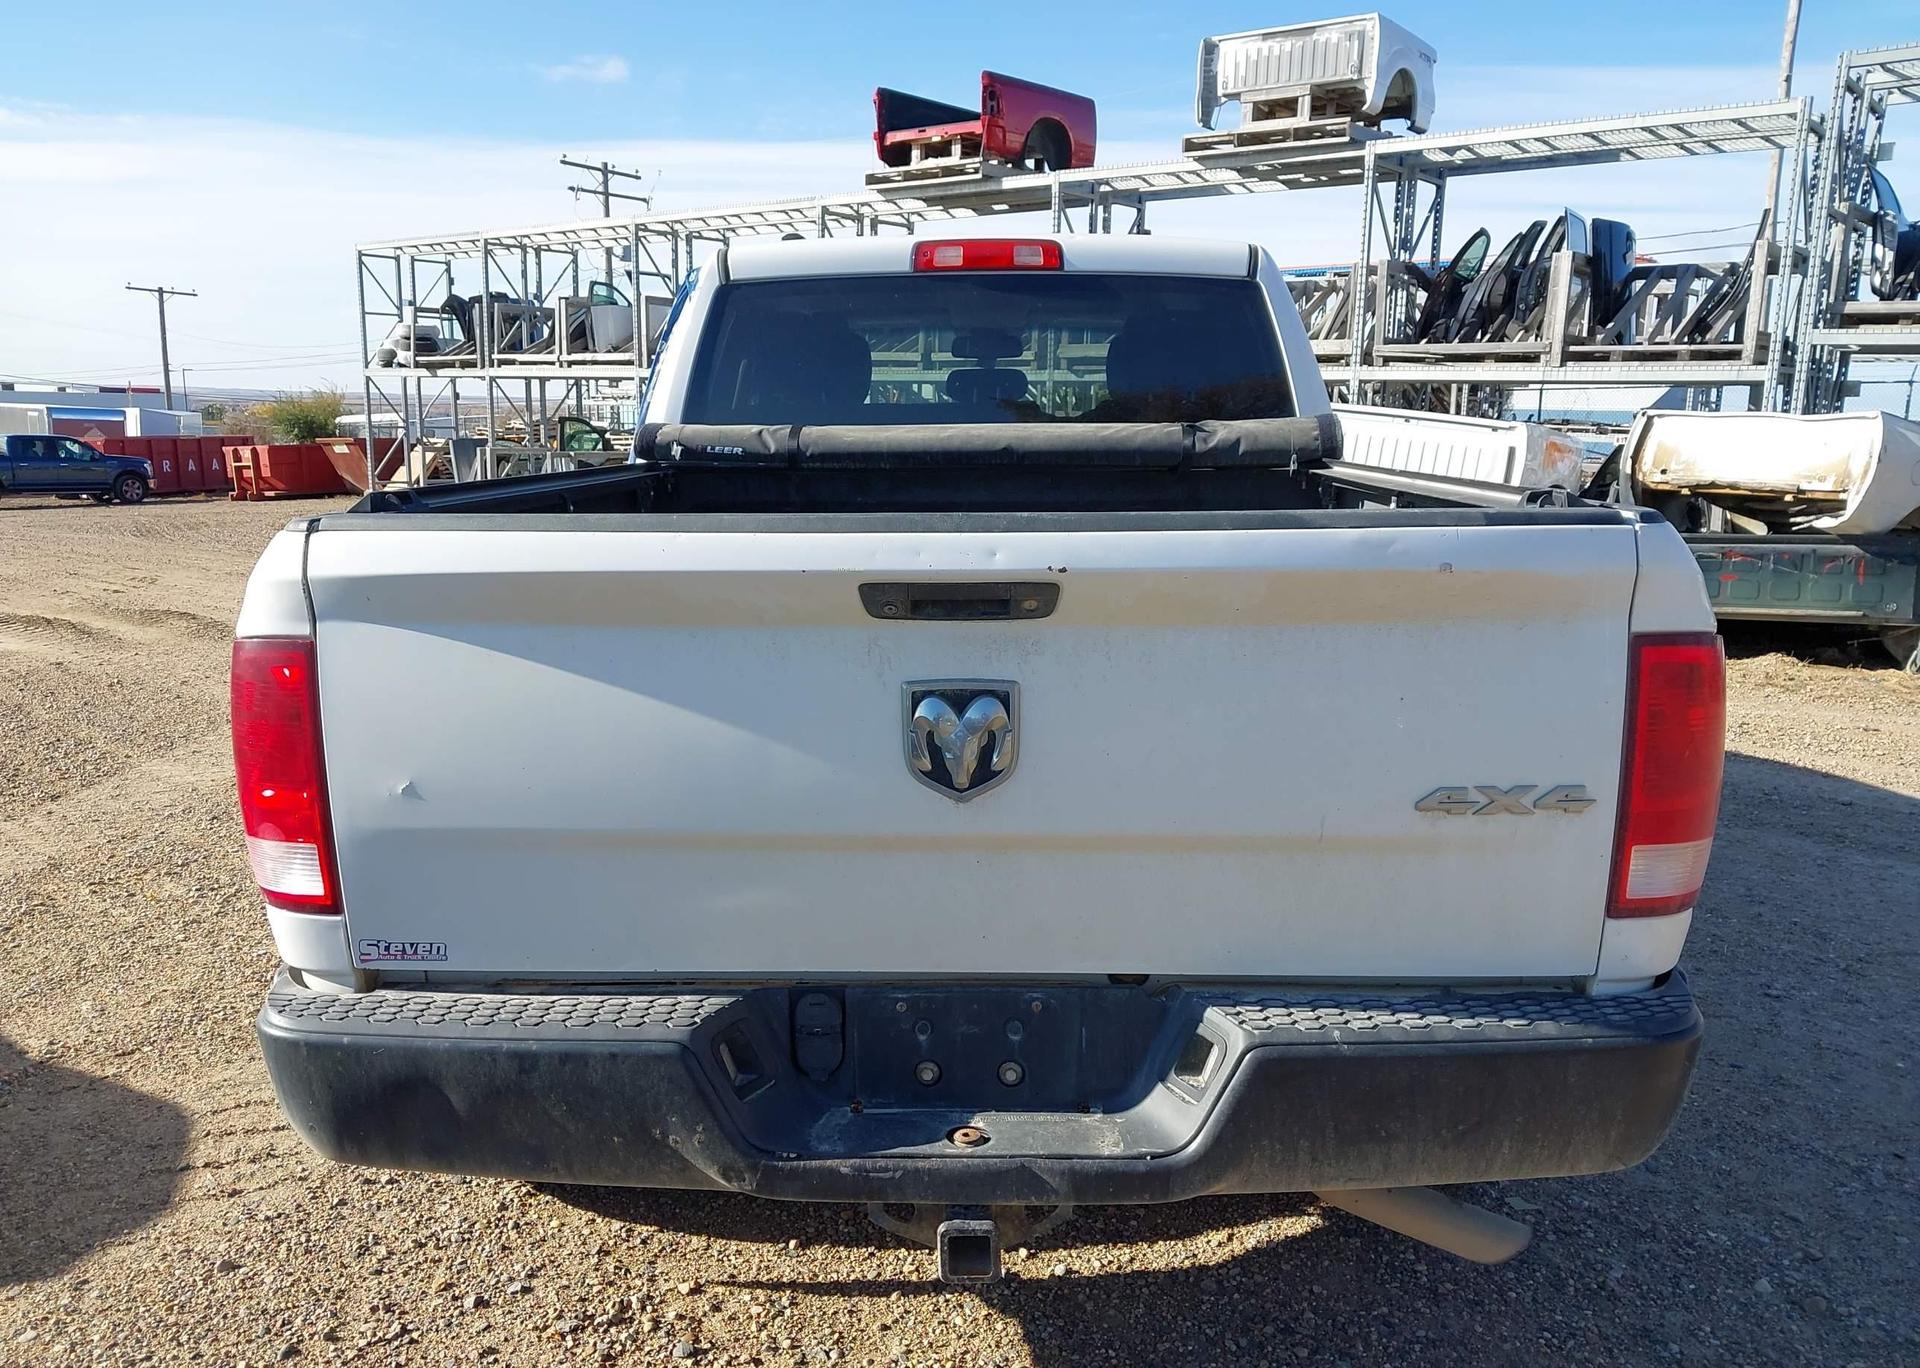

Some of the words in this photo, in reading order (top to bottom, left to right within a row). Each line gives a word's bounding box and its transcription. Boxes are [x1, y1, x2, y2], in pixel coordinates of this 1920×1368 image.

[706, 445, 744, 455] LEER
[1415, 785, 1597, 815] 4X4
[359, 939, 447, 960] Steven
